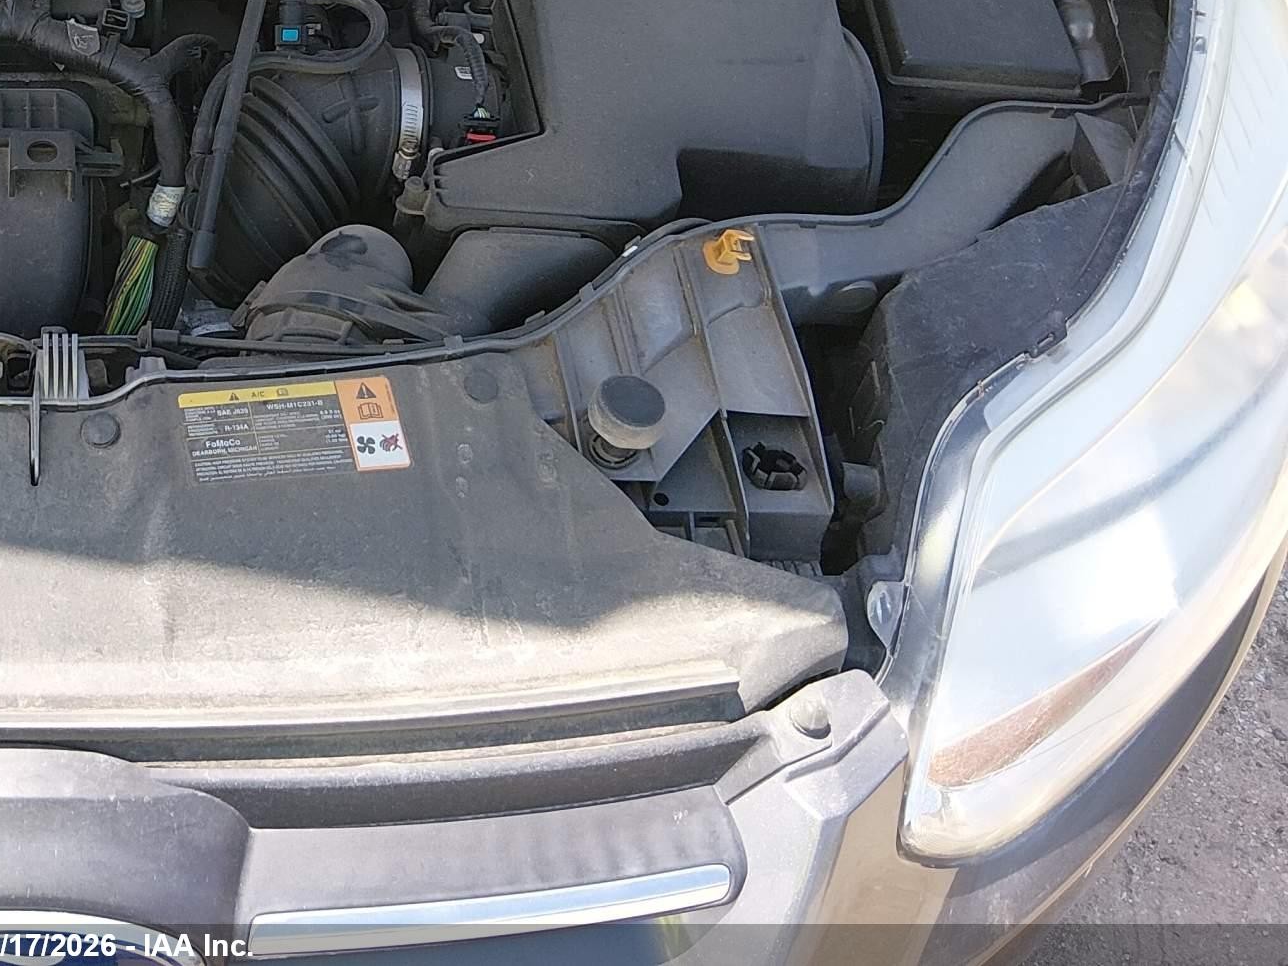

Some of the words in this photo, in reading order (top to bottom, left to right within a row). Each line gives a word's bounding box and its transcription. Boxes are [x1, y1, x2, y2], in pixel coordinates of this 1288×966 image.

[251, 390, 265, 398] A/C
[216, 409, 232, 417] SAE
[224, 423, 249, 432] R-134A
[205, 438, 241, 448] FoMoCo
